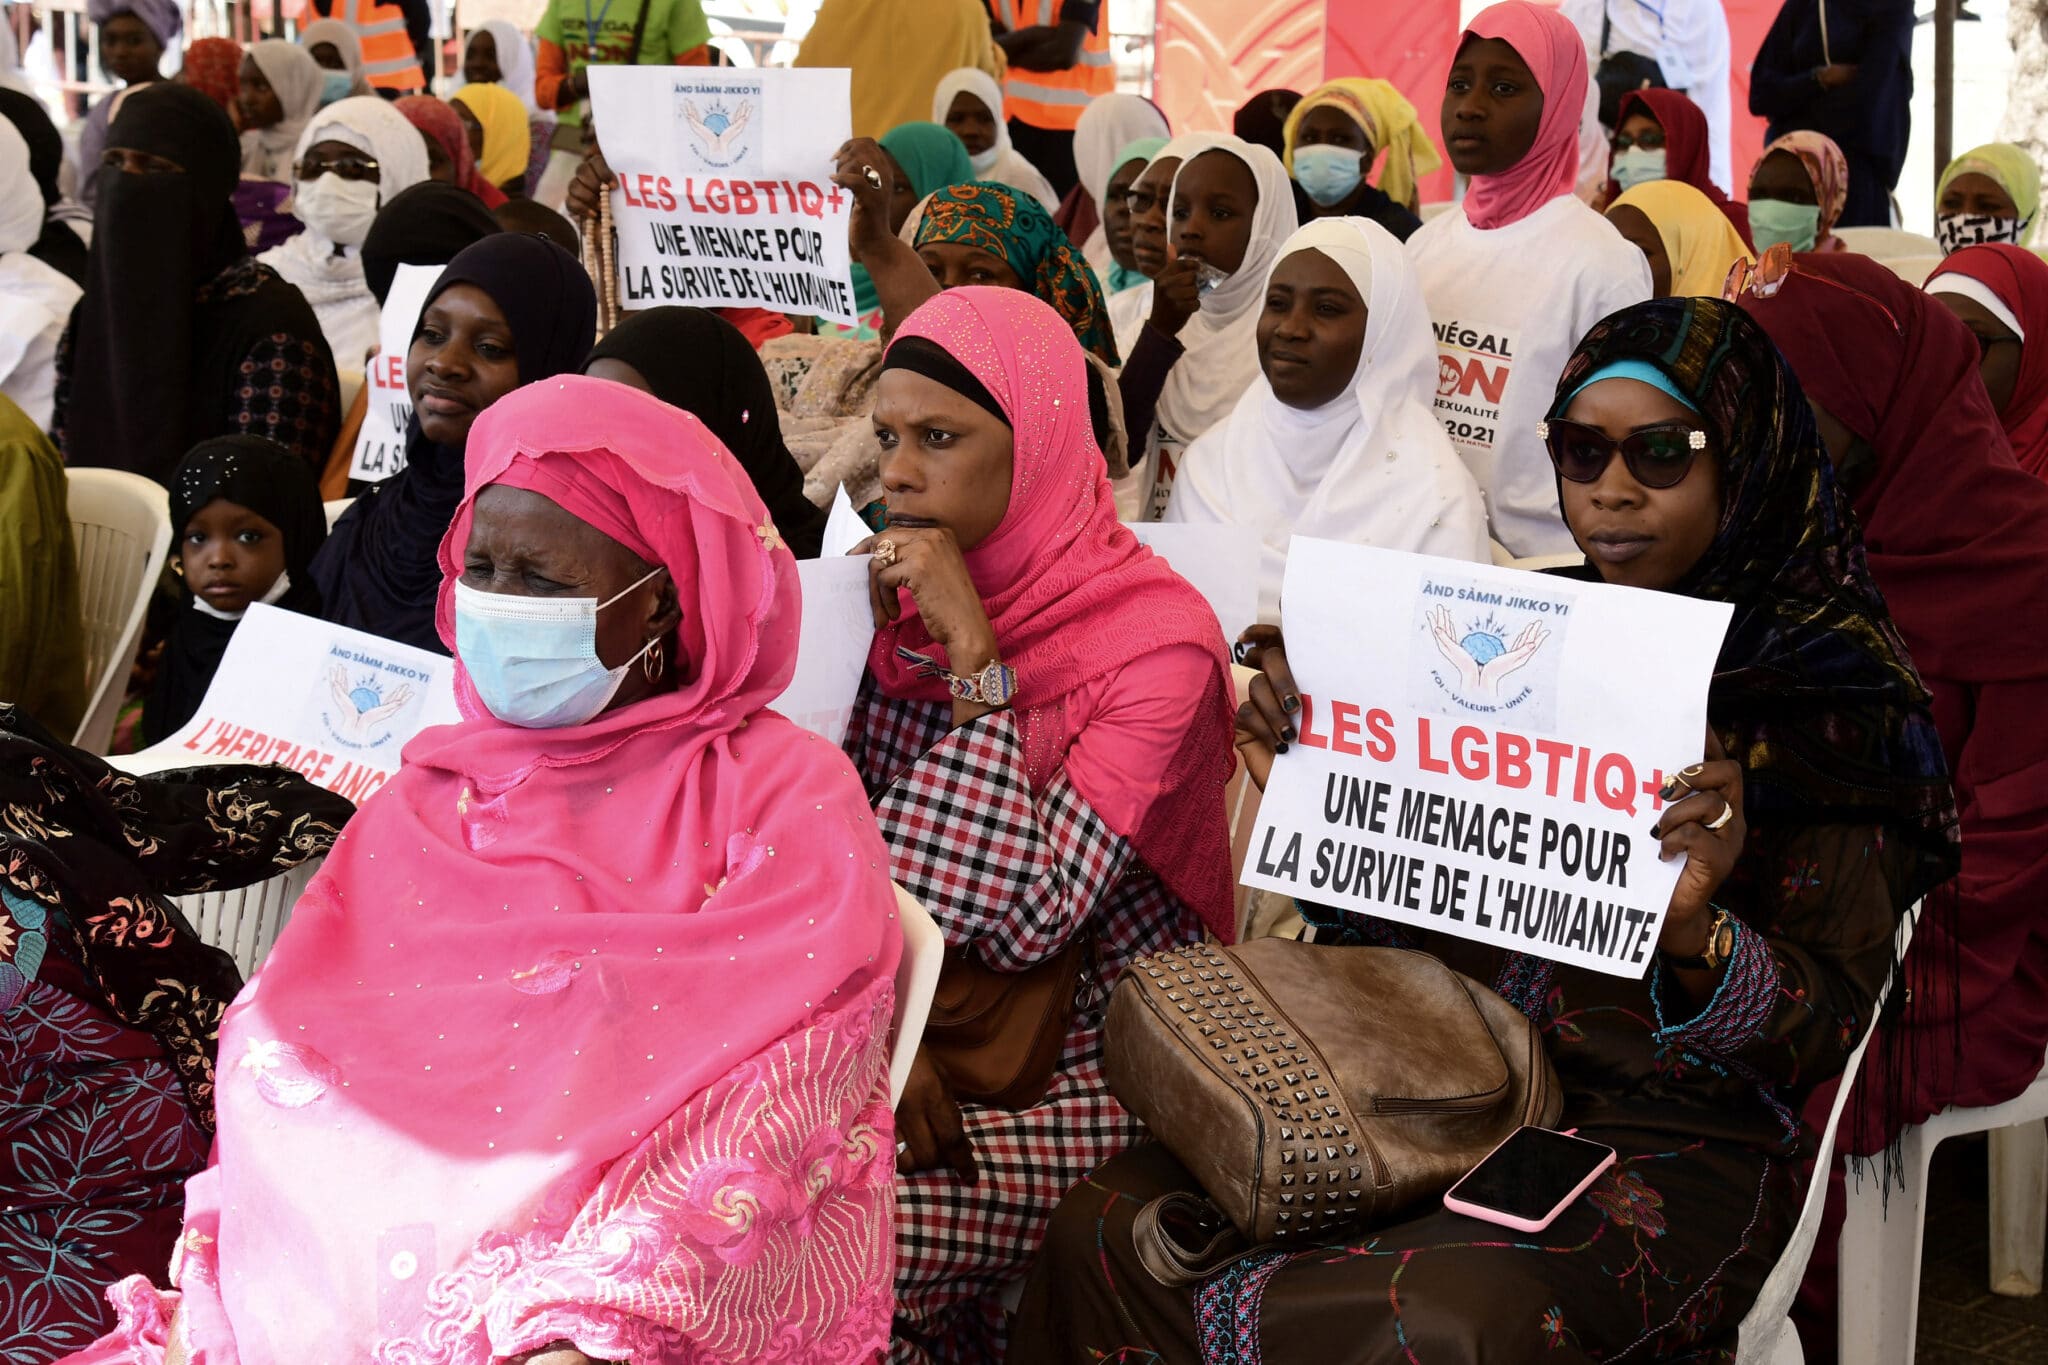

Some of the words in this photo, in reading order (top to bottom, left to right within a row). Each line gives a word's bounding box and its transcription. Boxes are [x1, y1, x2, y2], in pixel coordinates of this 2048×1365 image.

[752, 87, 760, 95] YI
[618, 172, 677, 213] LES
[685, 177, 844, 220] LGBTIQ+
[649, 221, 691, 257] UNE
[690, 224, 773, 262] MENACE
[774, 226, 824, 268] POUR
[625, 264, 655, 300] LA
[660, 264, 732, 300] SURVIE
[730, 266, 759, 299] DE
[756, 271, 851, 317] L'HUMANITE
[1432, 321, 1512, 357] NÉGAL
[374, 355, 407, 390] LE
[1436, 354, 1510, 405] ON
[390, 403, 412, 434] UN
[1434, 398, 1500, 421] SEXUALITÉ
[1444, 419, 1495, 444] 2021
[360, 439, 385, 473] LA
[1505, 596, 1550, 613] JIKKO
[1554, 603, 1569, 616] YI
[385, 663, 416, 679] JIKKO
[418, 672, 430, 683] YI
[1451, 692, 1497, 713] VALEURS
[183, 717, 334, 783] L'HERITAGE
[327, 761, 390, 805] ANC
[1298, 693, 1397, 763] LES
[1416, 716, 1666, 818] LGBTIQ+
[1323, 772, 1392, 834] UNE
[1396, 787, 1532, 866] MENACE
[1538, 816, 1632, 889] POUR
[1255, 825, 1303, 883] LA
[1309, 837, 1424, 911] SURVIE
[1430, 863, 1470, 922] DE
[1475, 873, 1658, 965] L'HUMANITE
